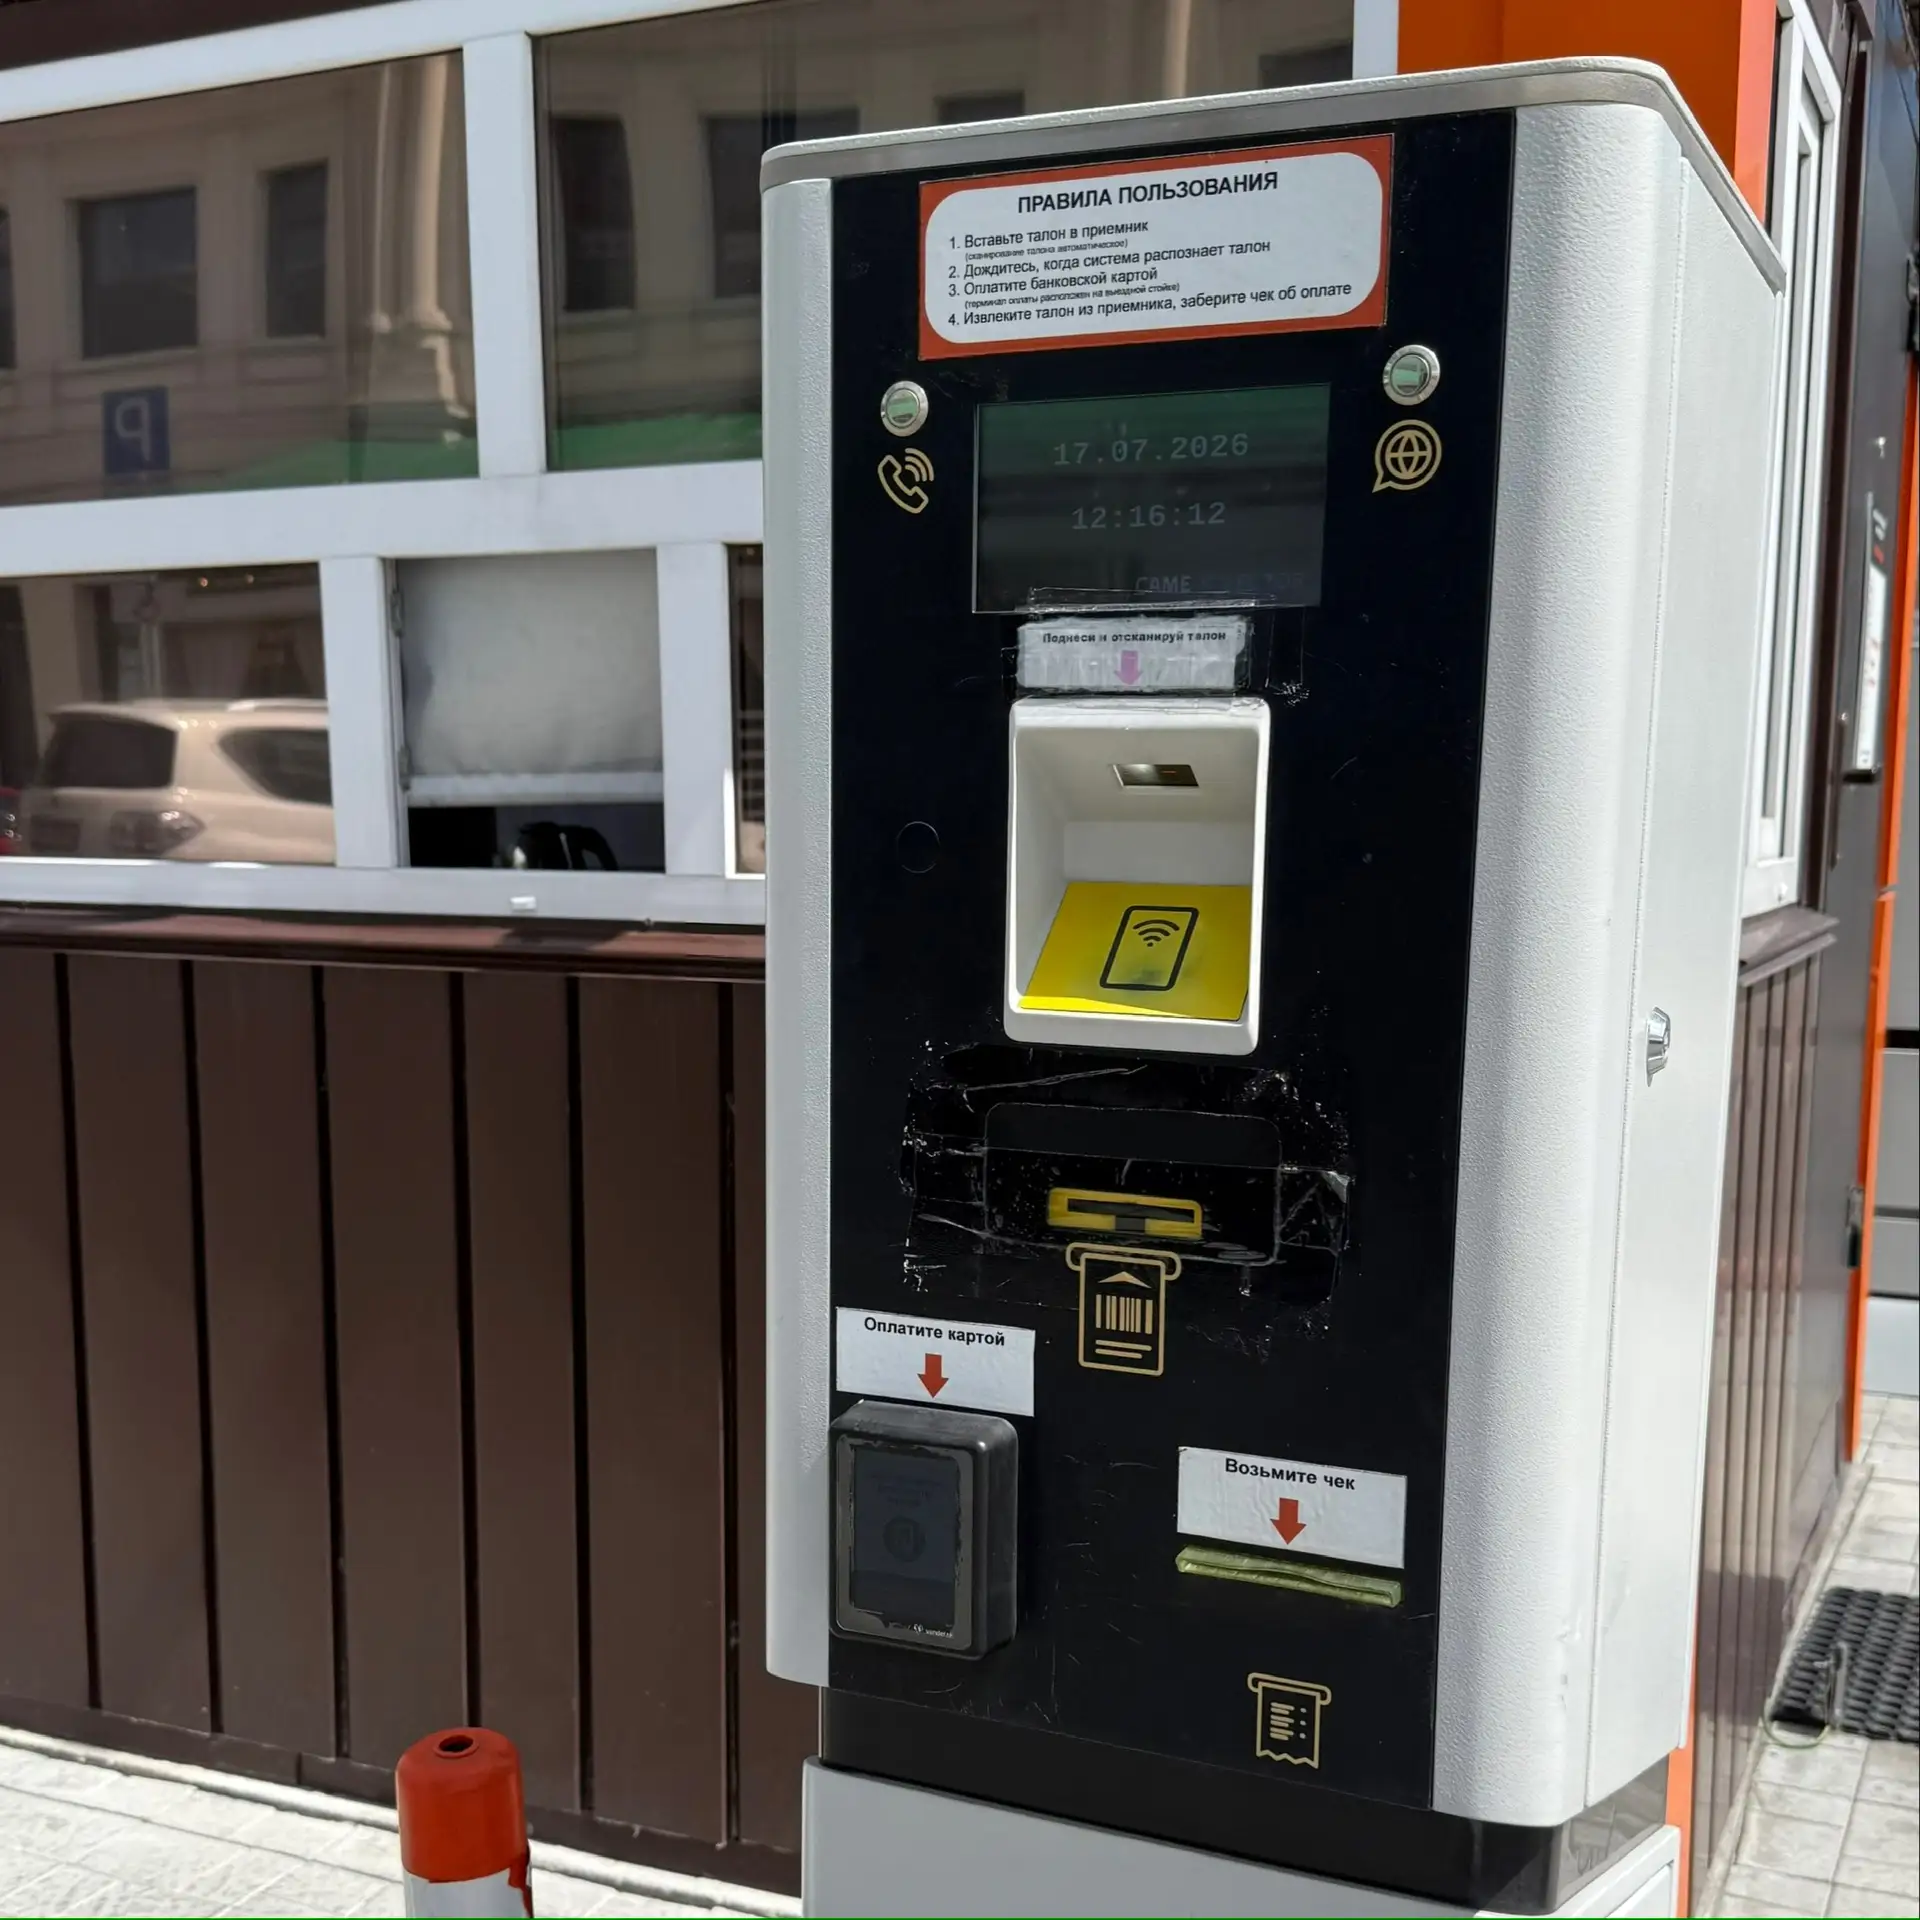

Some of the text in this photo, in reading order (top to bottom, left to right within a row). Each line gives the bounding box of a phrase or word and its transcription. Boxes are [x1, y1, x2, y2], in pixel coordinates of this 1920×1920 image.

[1018, 171, 1279, 214] ПРАВИЛА ПОЛЬЗОВАНИЯ
[949, 221, 1149, 249] 1. Вставьте талон в приемник
[948, 240, 1271, 280] 2. Дождитесь, когда система распознает талон
[948, 267, 1158, 297] 3. Оплатите банковской картой
[948, 283, 1352, 326] 4. Извлеките талон из приемника, заберите чек об оплате
[1053, 432, 1249, 467] 17.07.2026
[1071, 501, 1227, 531] 12:16:12
[1043, 630, 1226, 643] Поднеси и отсканируй талон
[864, 1316, 1005, 1346] Оплатите картой
[1225, 1457, 1355, 1490] Возьмите чек
